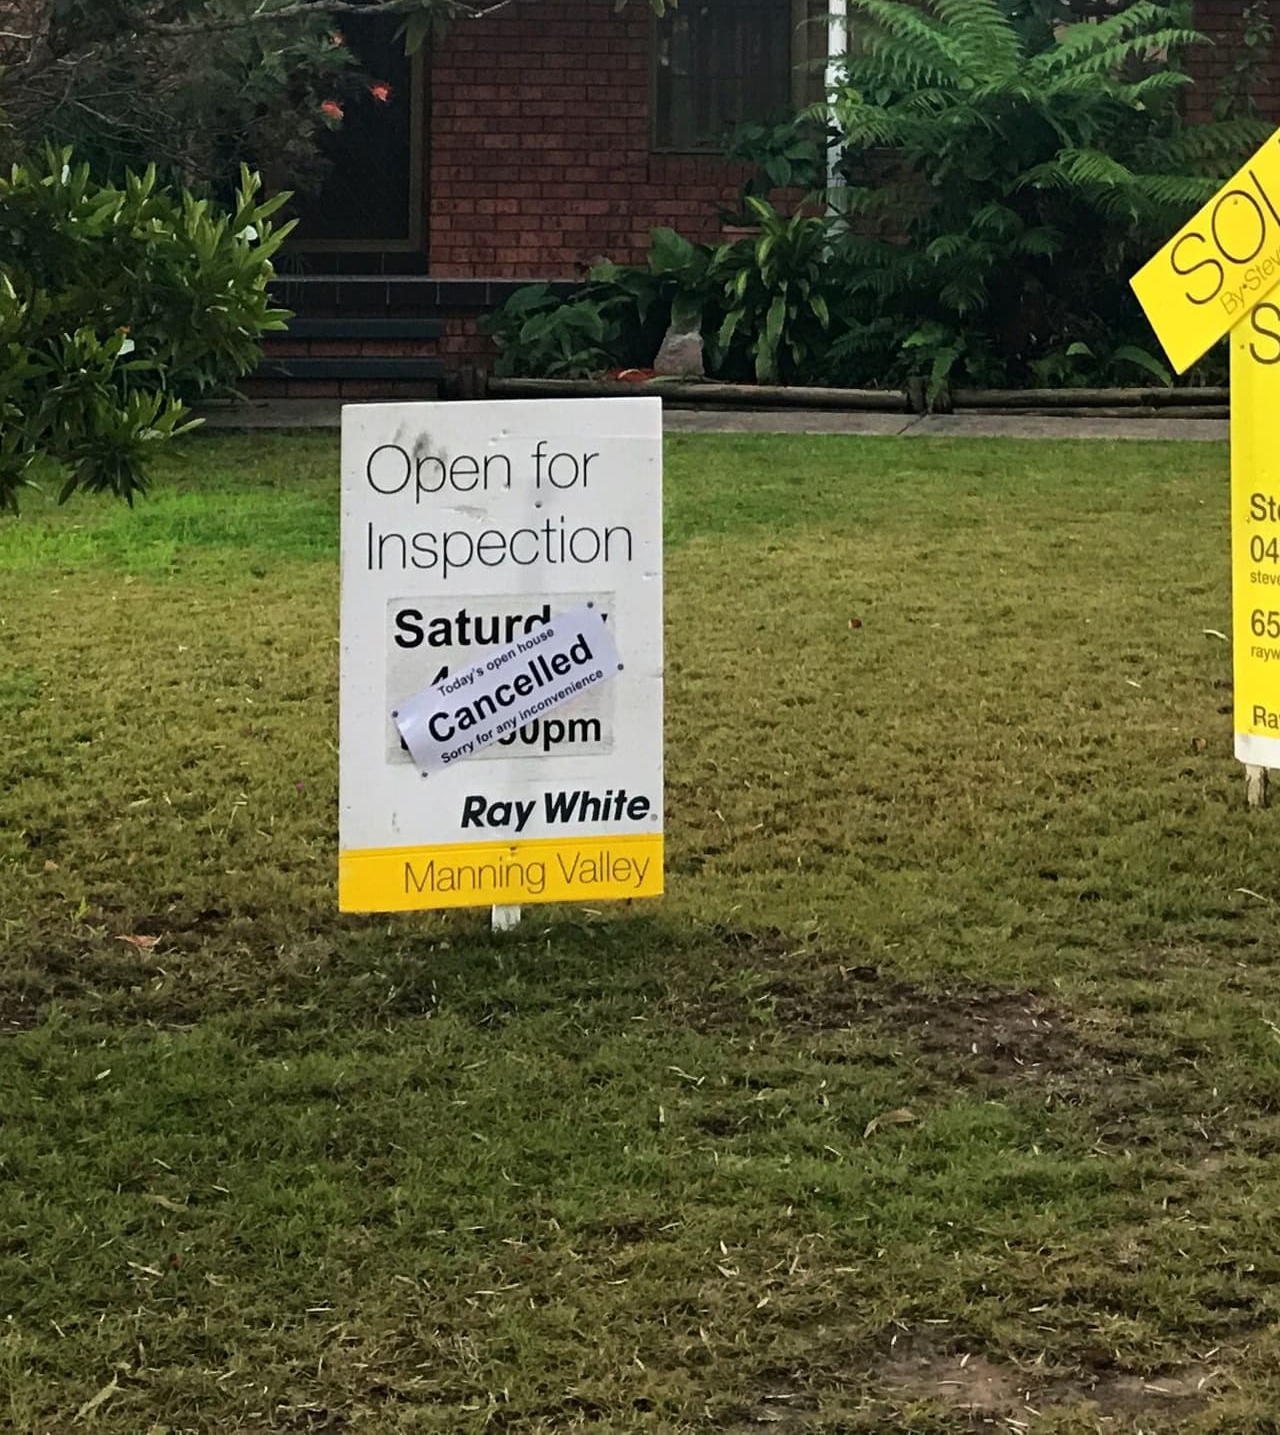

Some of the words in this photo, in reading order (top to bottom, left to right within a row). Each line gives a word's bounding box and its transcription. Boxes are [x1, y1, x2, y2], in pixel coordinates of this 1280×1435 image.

[1219, 279, 1248, 317] By
[366, 444, 512, 504] Open
[531, 440, 600, 489] for
[367, 515, 633, 580] Inspection
[394, 604, 609, 649] Saturd
[428, 633, 594, 742] Cancelled
[438, 667, 485, 697] Today's
[486, 648, 517, 673] open
[517, 626, 555, 654] house
[440, 742, 476, 765] Sorry
[475, 730, 495, 746] for
[495, 716, 518, 737] any
[519, 667, 604, 721] inconvenience
[460, 794, 536, 833] Ray
[404, 855, 546, 895] Manning
[556, 850, 651, 889] Valley
